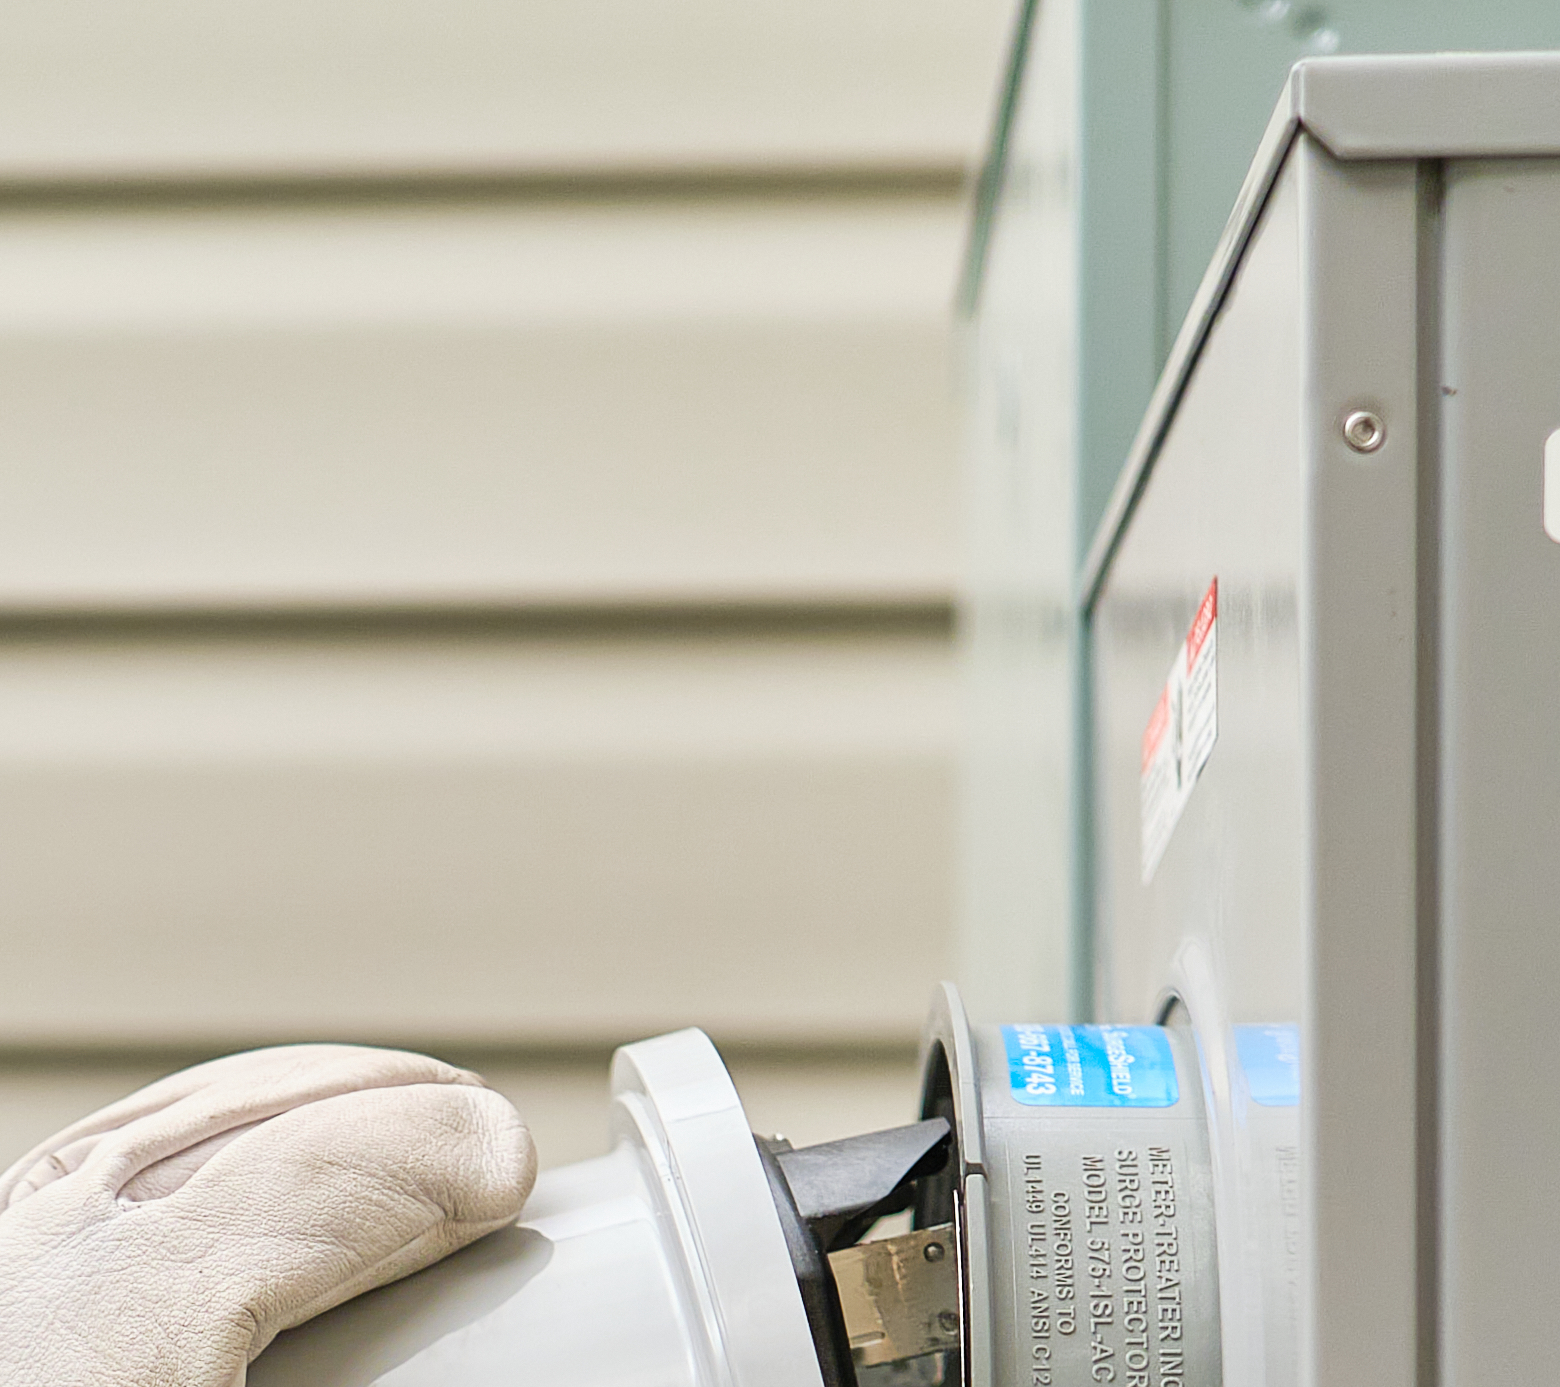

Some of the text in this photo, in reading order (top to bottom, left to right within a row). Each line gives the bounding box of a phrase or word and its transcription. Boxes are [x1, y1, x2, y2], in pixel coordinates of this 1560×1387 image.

[1081, 1155, 1104, 1231] MODEL
[1113, 1147, 1145, 1224] SURGE
[1051, 1191, 1076, 1336] CONFORMS TO
[1147, 1146, 1181, 1341] METER-TREATER
[1030, 1287, 1051, 1340] ANSI
